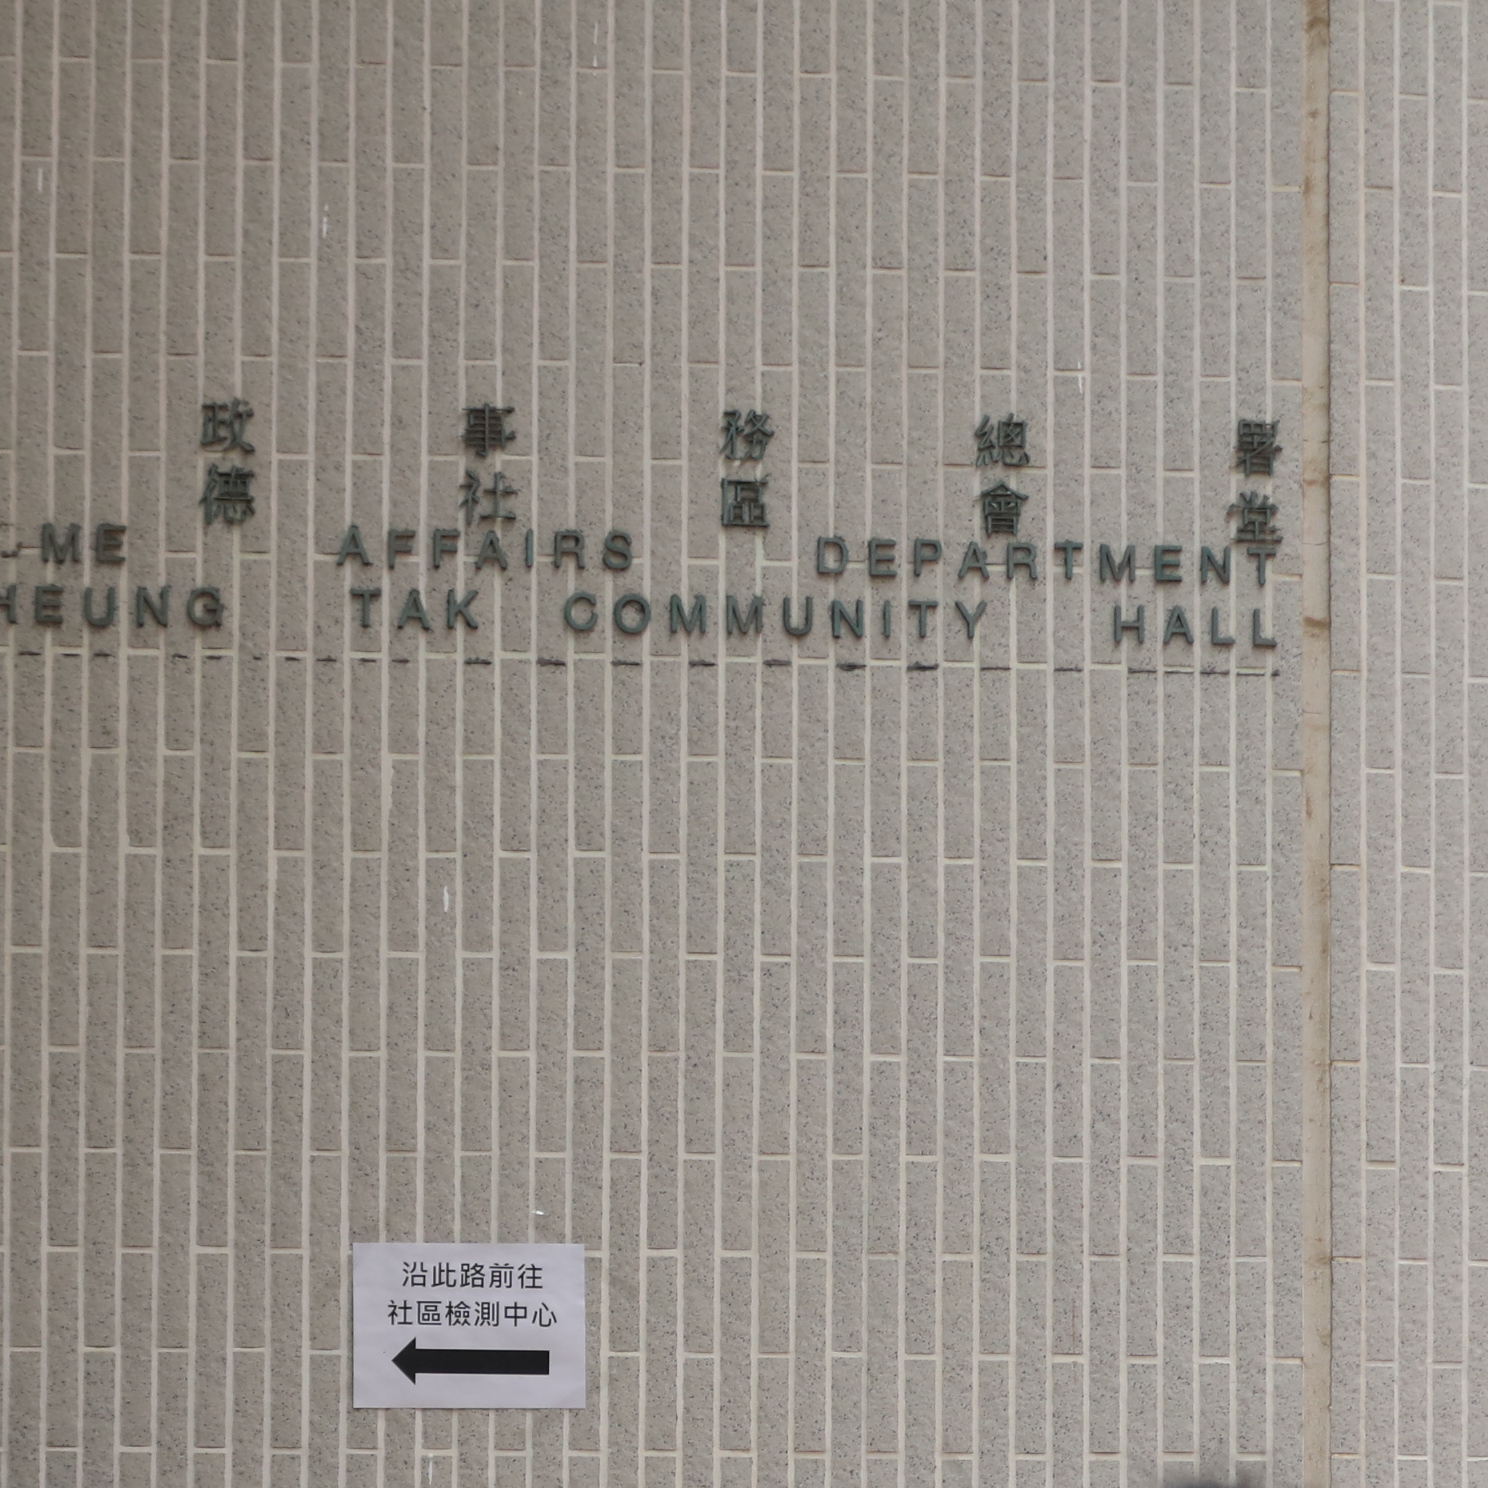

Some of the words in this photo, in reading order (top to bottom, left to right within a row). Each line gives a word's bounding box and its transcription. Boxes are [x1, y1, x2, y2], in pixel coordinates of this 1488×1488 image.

[335, 524, 634, 572] AFFAIRS
[815, 535, 1278, 587] DEPARTMENT
[349, 587, 481, 632] TAK
[562, 592, 988, 640] COMMUNITY
[1112, 604, 1278, 649] HALL
[400, 1260, 545, 1290] 沿此路前往
[386, 1299, 558, 1329] 社區檢測中心
